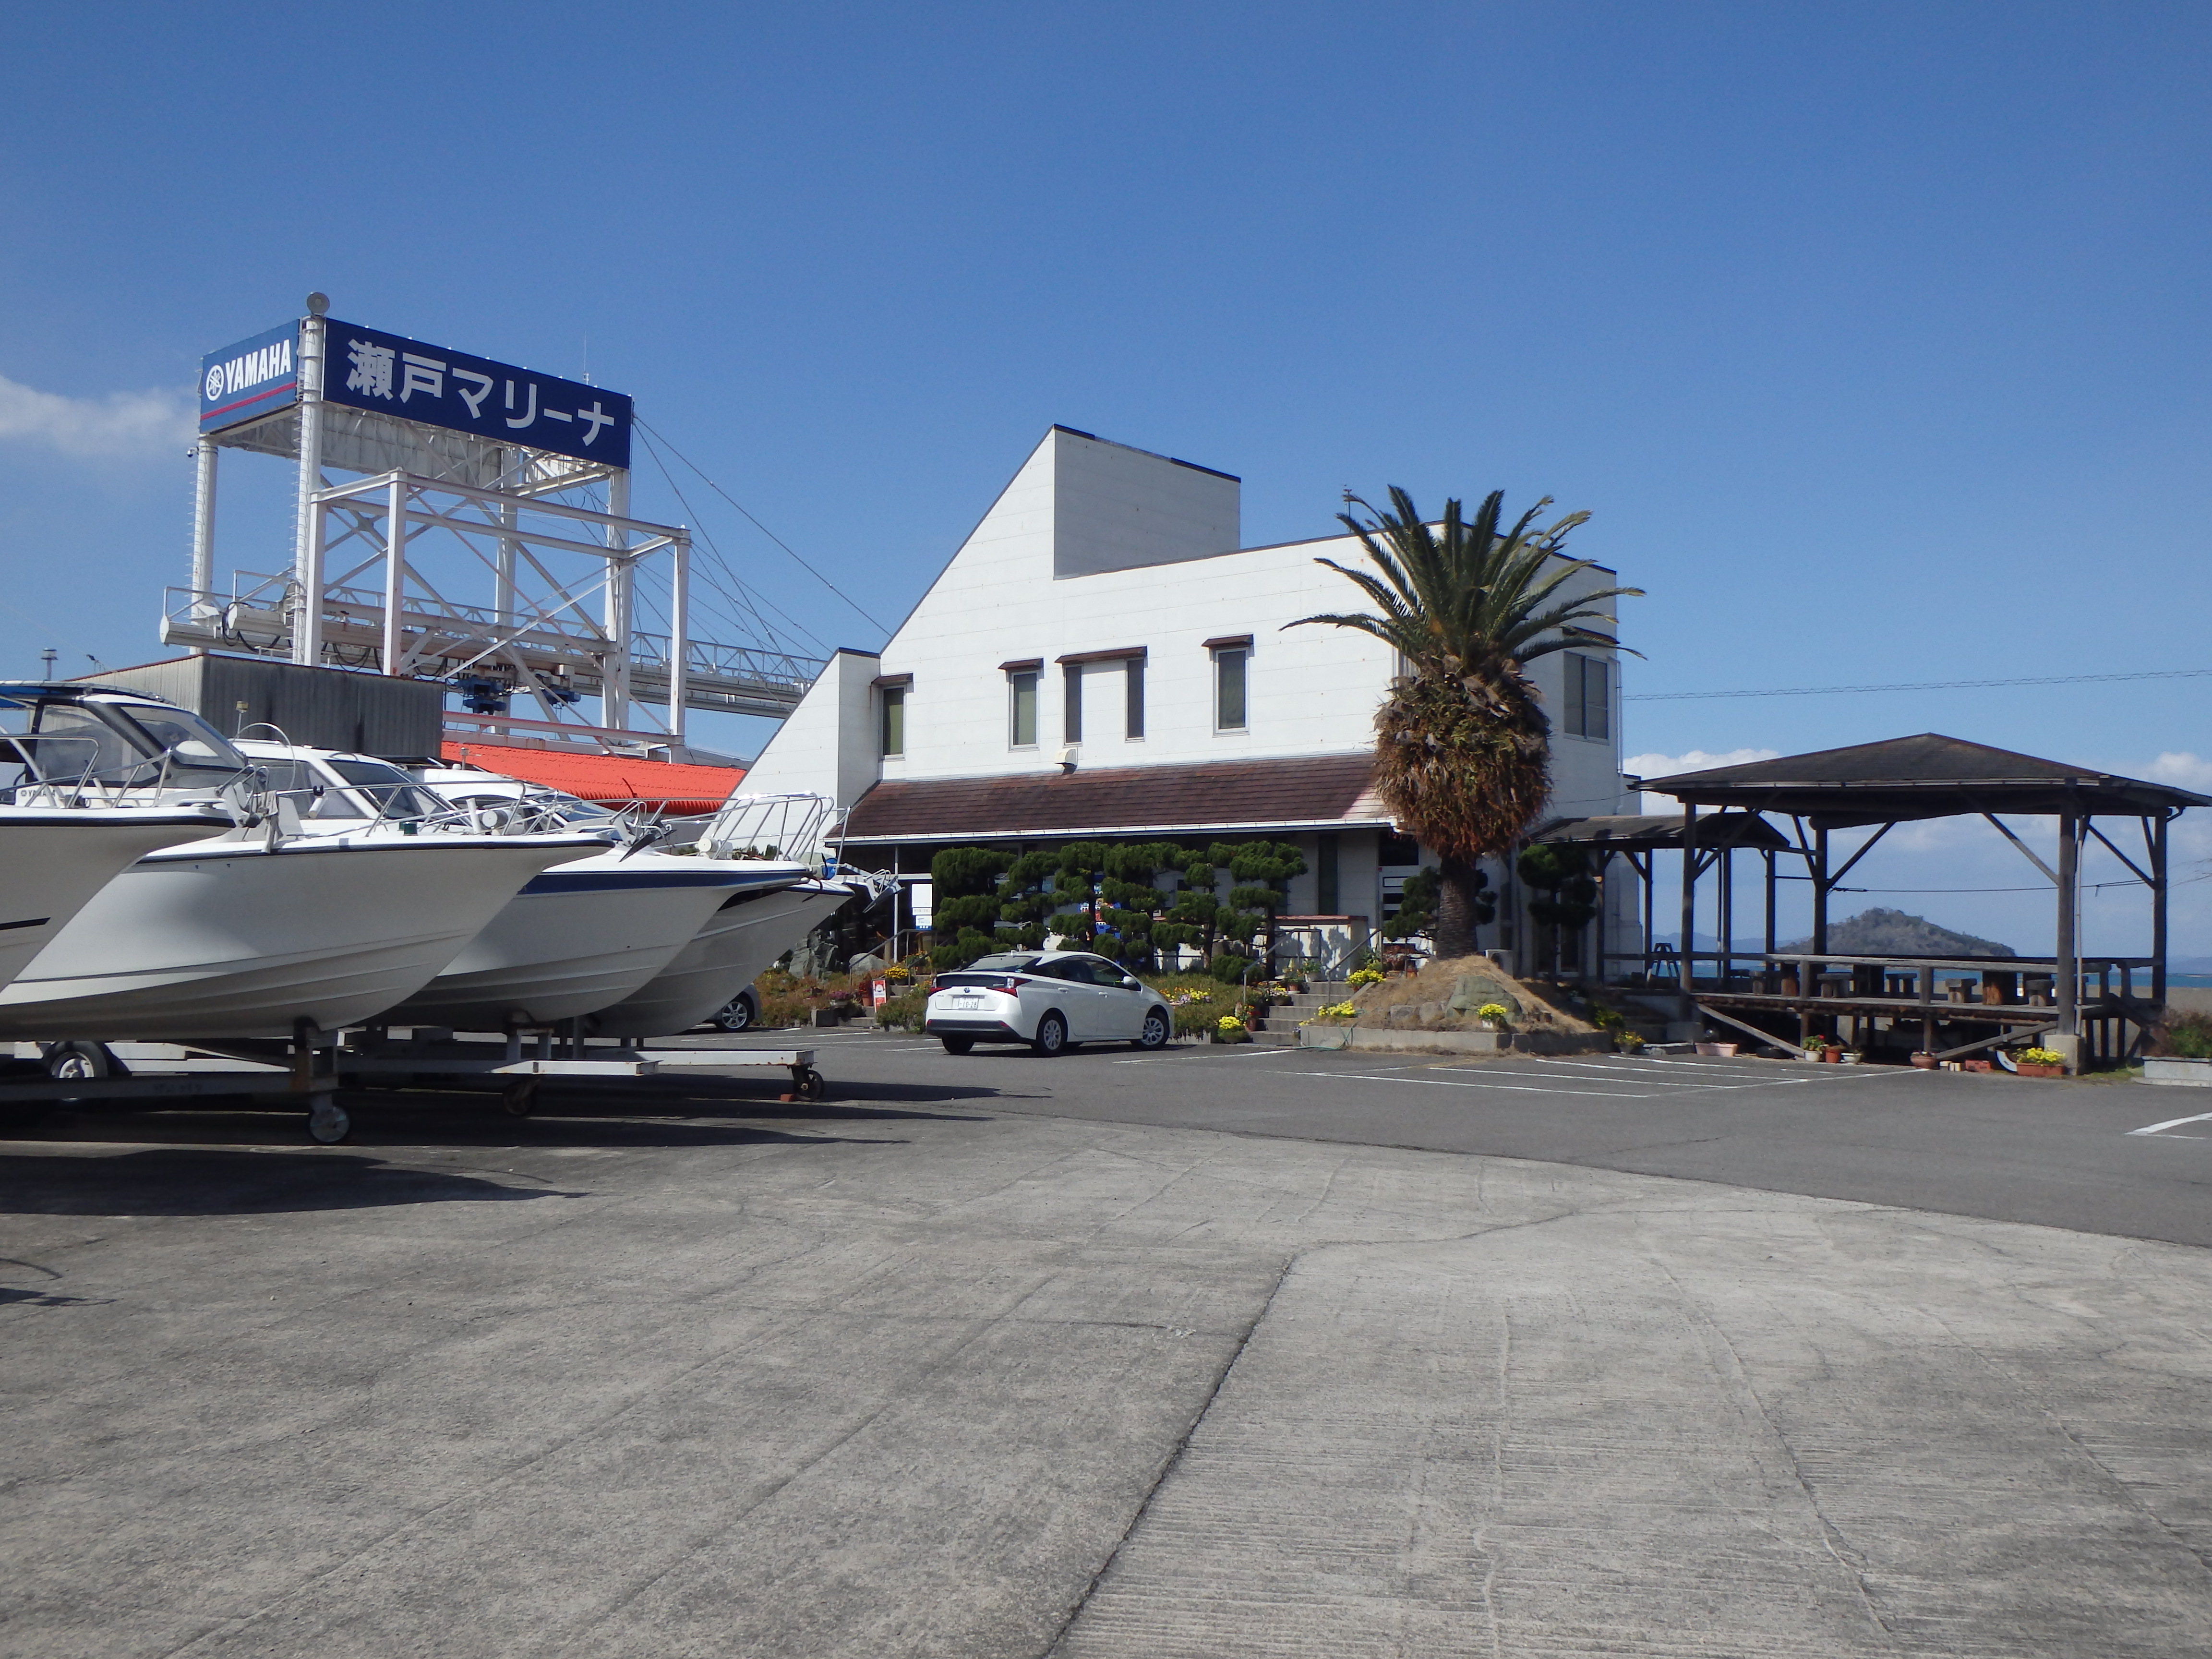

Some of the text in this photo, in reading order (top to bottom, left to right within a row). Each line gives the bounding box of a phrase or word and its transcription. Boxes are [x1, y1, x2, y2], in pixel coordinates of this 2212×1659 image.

[225, 339, 291, 394] YAMAHA
[346, 338, 615, 446] 瀬戸マリーナ
